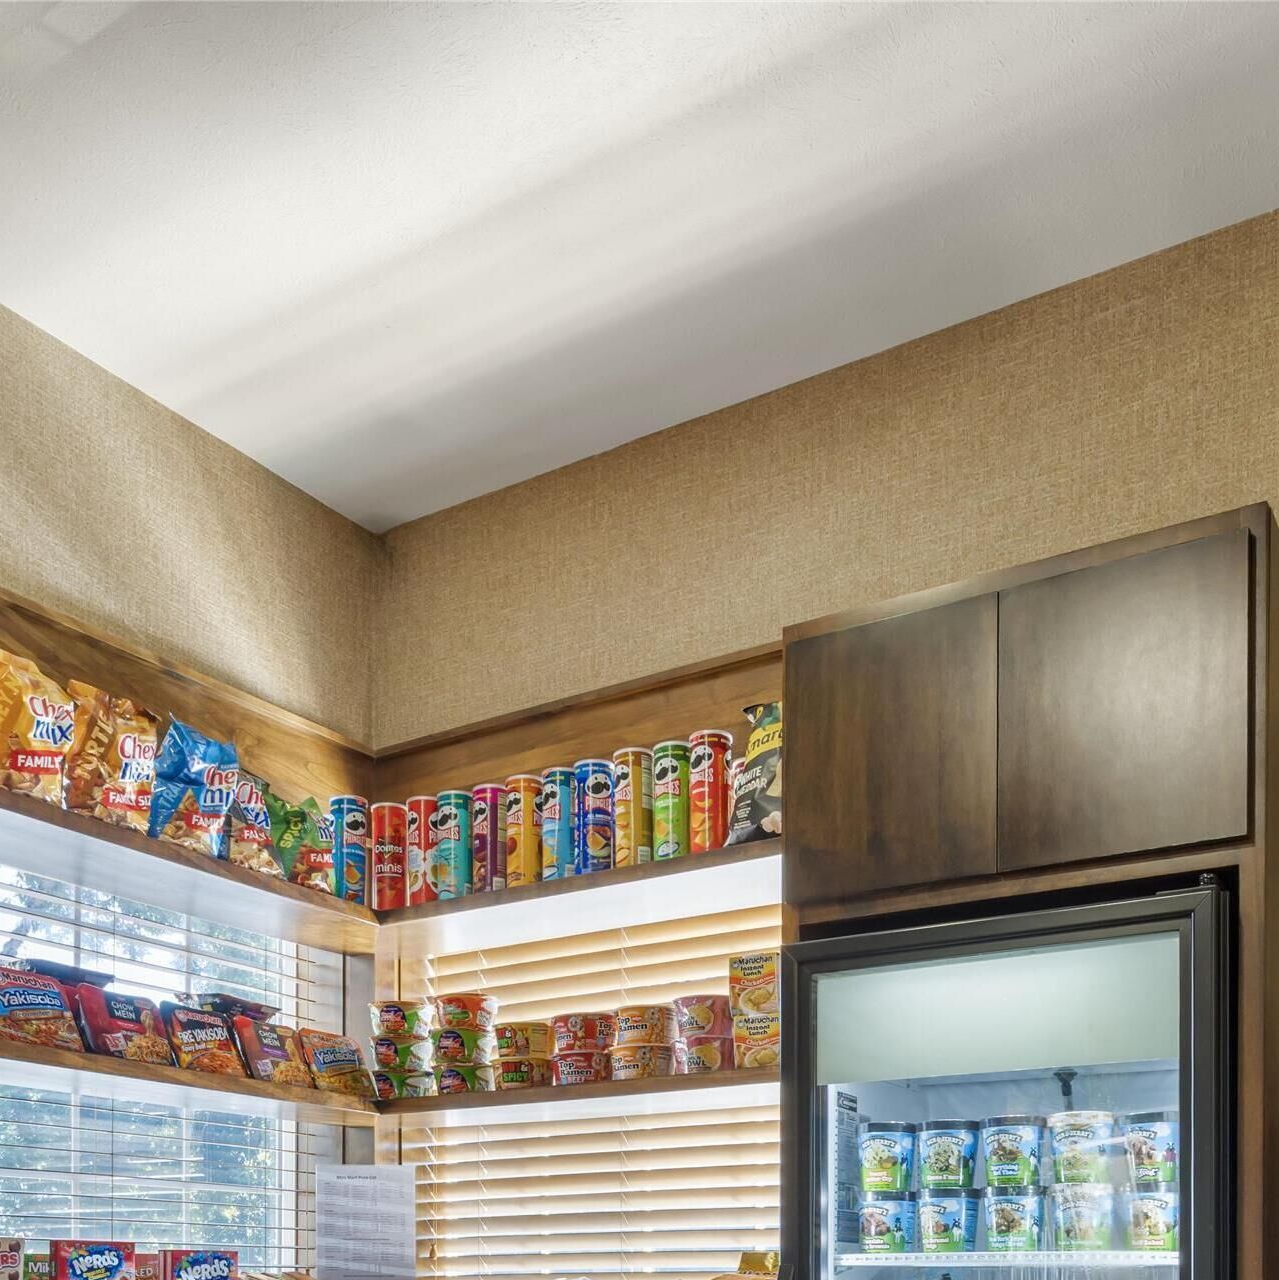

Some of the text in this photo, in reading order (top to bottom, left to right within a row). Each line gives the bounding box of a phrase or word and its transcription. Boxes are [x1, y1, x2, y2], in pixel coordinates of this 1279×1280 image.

[28, 696, 73, 722] Chex
[17, 754, 61, 768] FAMILY
[375, 844, 403, 855] Doritos
[375, 863, 403, 874] minis
[738, 955, 773, 966] Maruchan
[2, 971, 55, 990] Maruchan
[111, 1001, 134, 1012] CHOW
[114, 1009, 136, 1019] MEIN
[743, 1015, 779, 1025] Maruchan
[192, 1027, 229, 1042] YAKISOBA
[559, 1061, 575, 1072] Top
[503, 1073, 528, 1083] SPICY
[561, 1068, 592, 1077] Ramen
